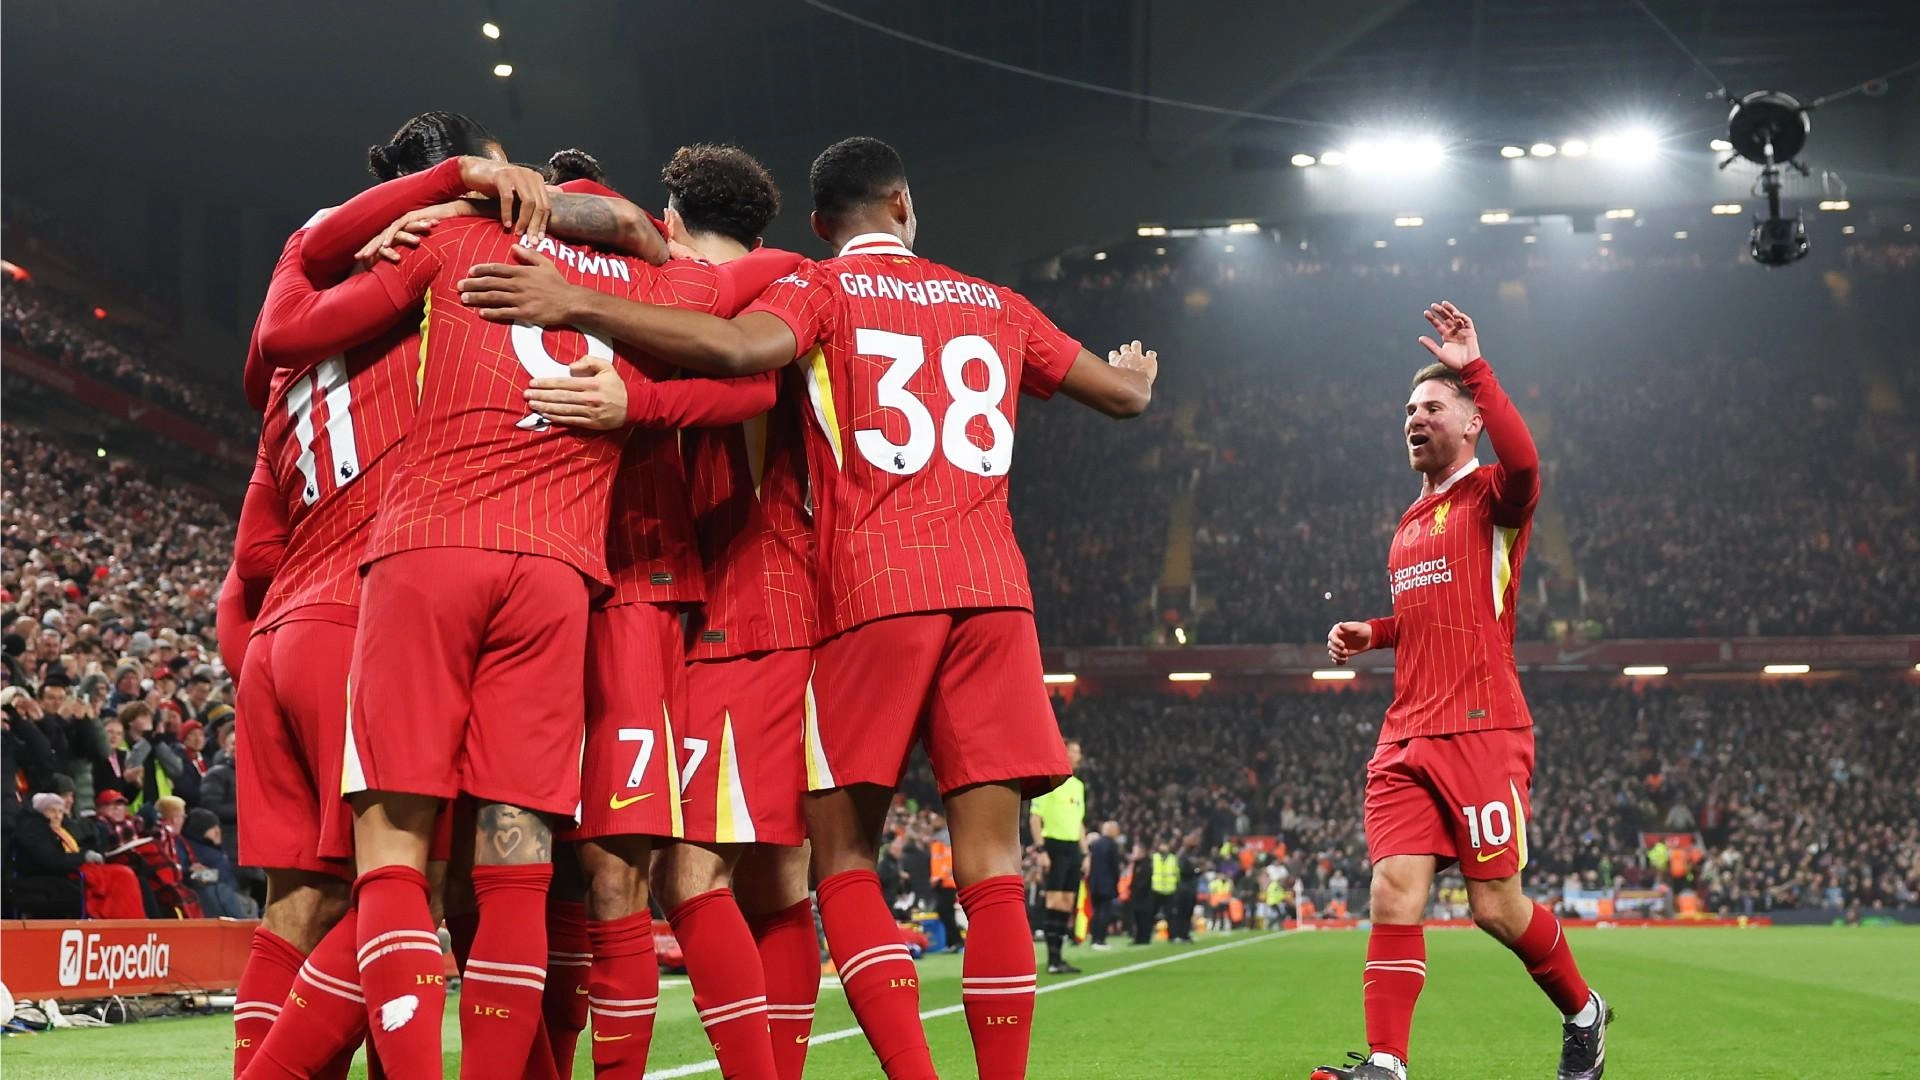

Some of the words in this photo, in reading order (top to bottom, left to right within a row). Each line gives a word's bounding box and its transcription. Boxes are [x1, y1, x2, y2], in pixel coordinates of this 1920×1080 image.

[839, 273, 1001, 309] GRAVENBERCH
[853, 327, 1015, 477] 38
[286, 352, 360, 507] 11
[1394, 555, 1447, 583] standard
[1394, 568, 1453, 596] chartered
[618, 728, 655, 788] 7
[680, 737, 709, 795] 7
[1462, 800, 1512, 849] 10
[85, 932, 170, 990] Expedia
[416, 974, 444, 986] LFC
[890, 978, 916, 988] LFC
[474, 1004, 510, 1019] LFC
[986, 1015, 1018, 1025] LFC
